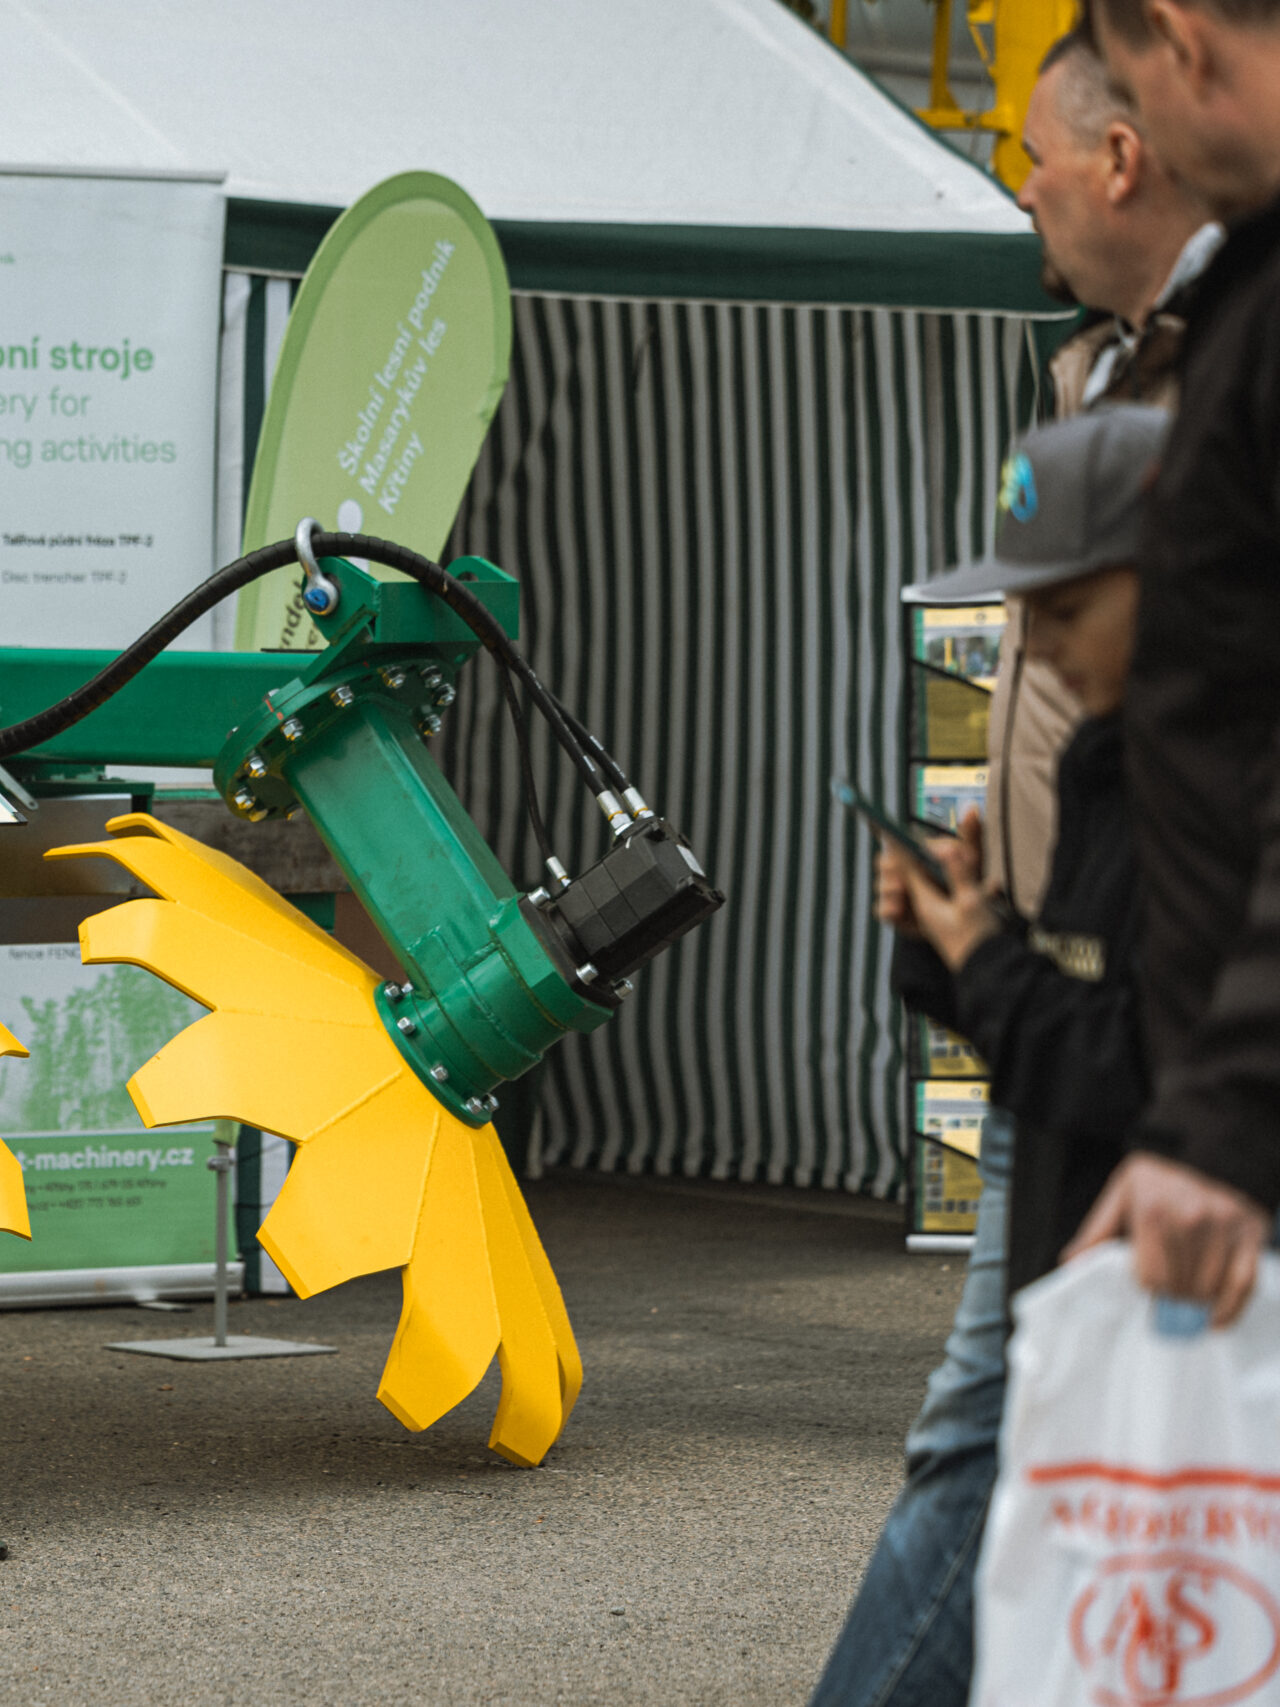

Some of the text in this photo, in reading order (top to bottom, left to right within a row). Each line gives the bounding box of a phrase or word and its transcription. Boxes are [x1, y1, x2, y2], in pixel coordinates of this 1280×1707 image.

[49, 338, 156, 380] stroje
[338, 237, 457, 475] Školní lesní podnik
[49, 386, 91, 418] for
[358, 316, 449, 498] Masarykův les
[40, 434, 177, 465] activities
[377, 430, 425, 516] Křtiny
[15, 1144, 195, 1172] t-machinery.cz
